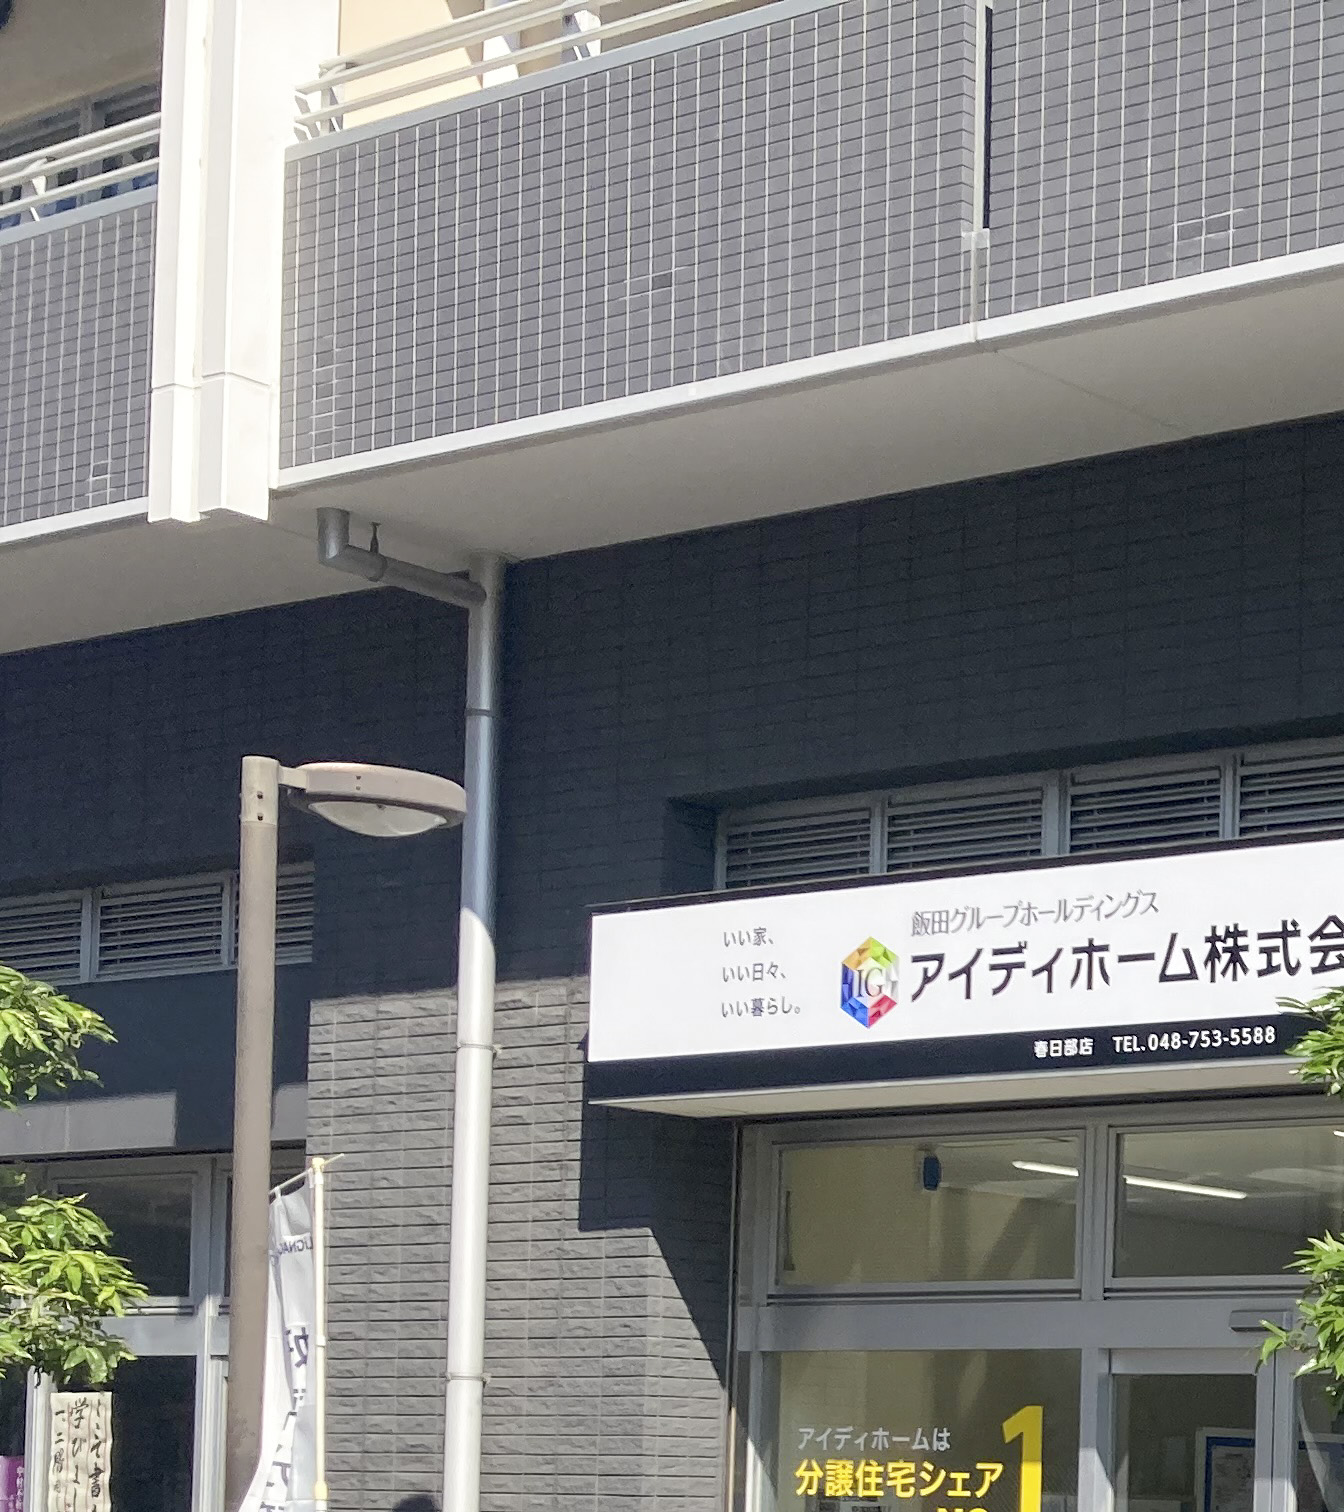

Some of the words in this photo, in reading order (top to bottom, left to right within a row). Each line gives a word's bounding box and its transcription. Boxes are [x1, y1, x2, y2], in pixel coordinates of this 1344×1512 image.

[911, 889, 1159, 937] 飯田グループホールディングス
[723, 927, 774, 947] いい家、
[722, 962, 786, 982] いい日々、
[721, 996, 800, 1018] いい暮らし。
[1034, 1038, 1094, 1058] 春日部店
[797, 1425, 952, 1453] アイディホームは
[794, 1458, 1004, 1499] 分譲住宅シェア
